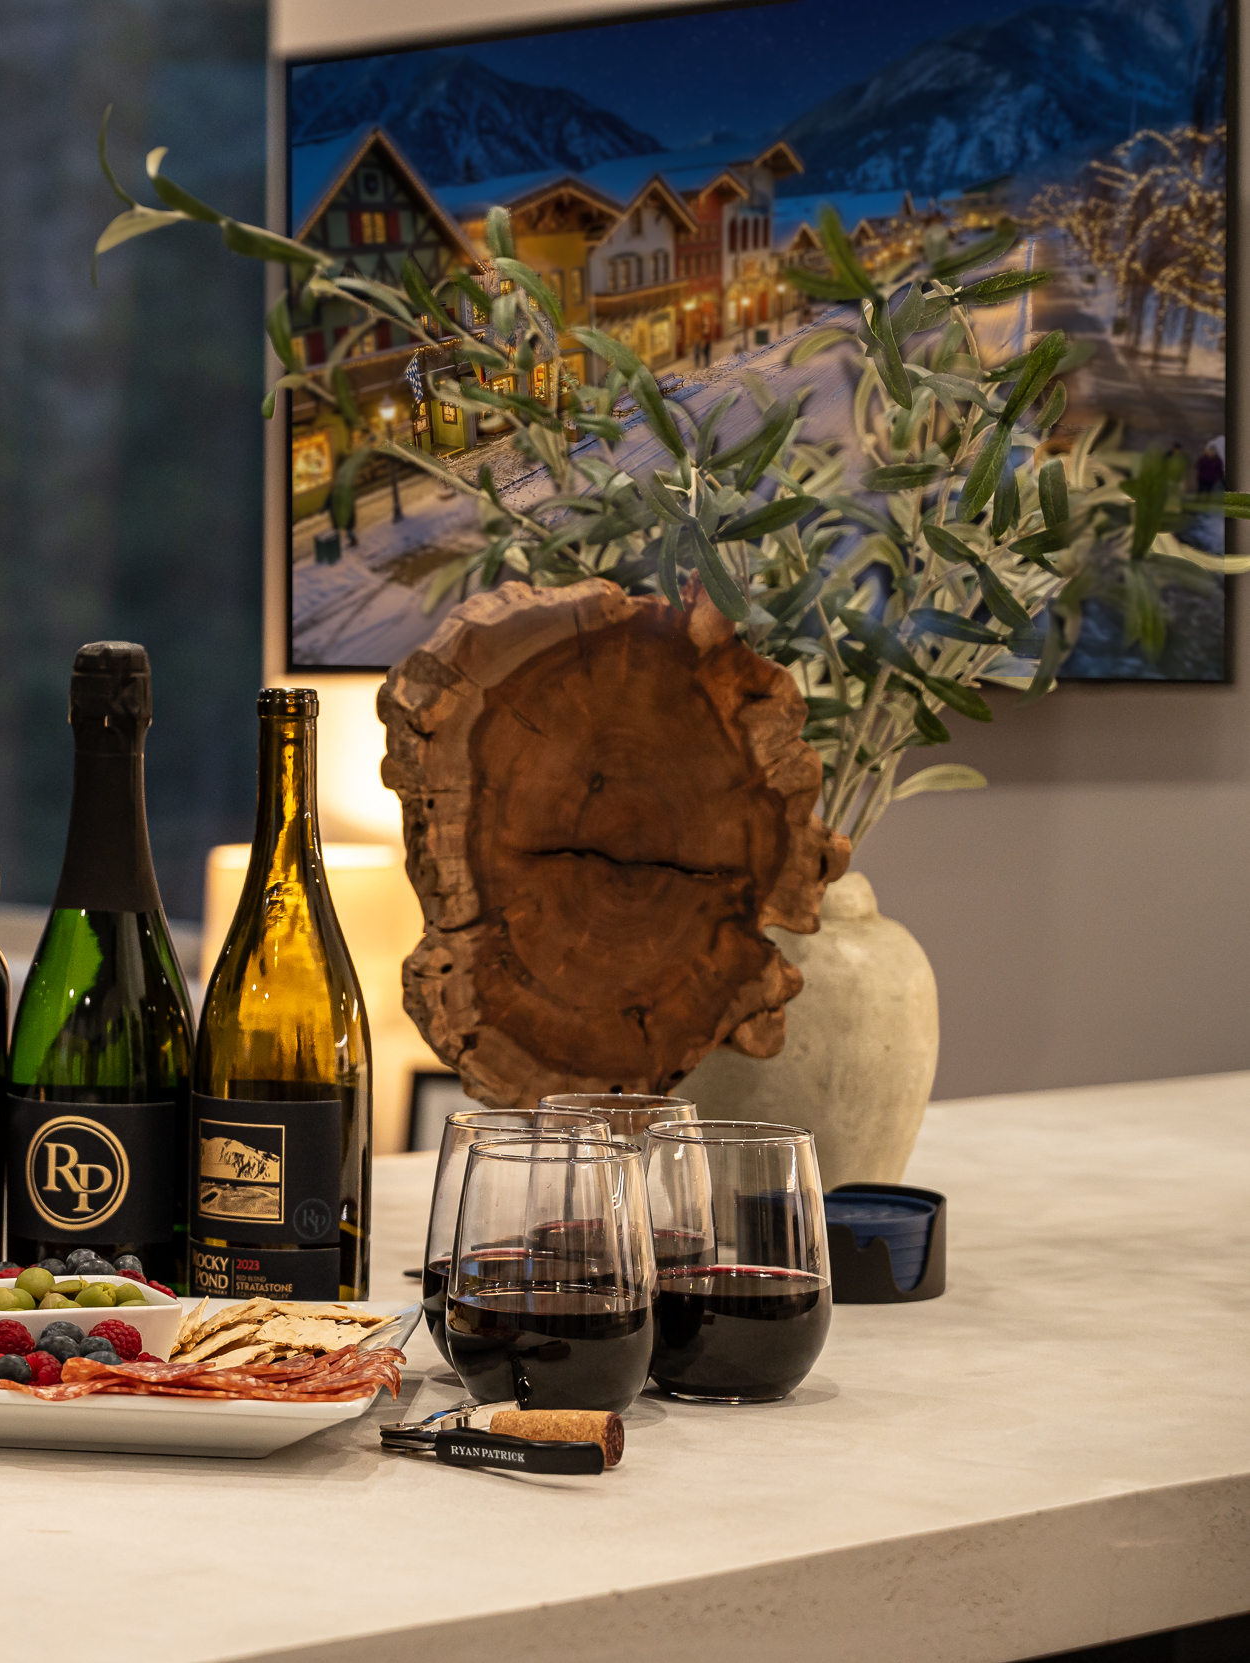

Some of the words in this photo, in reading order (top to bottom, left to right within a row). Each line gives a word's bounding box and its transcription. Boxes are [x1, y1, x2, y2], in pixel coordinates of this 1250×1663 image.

[192, 1248, 229, 1272] ROCKY
[236, 1259, 260, 1271] 2023
[195, 1266, 229, 1290] POND
[235, 1281, 293, 1293] STRATASTONE
[450, 1445, 480, 1456] RYAN
[481, 1448, 525, 1462] PATRICK
